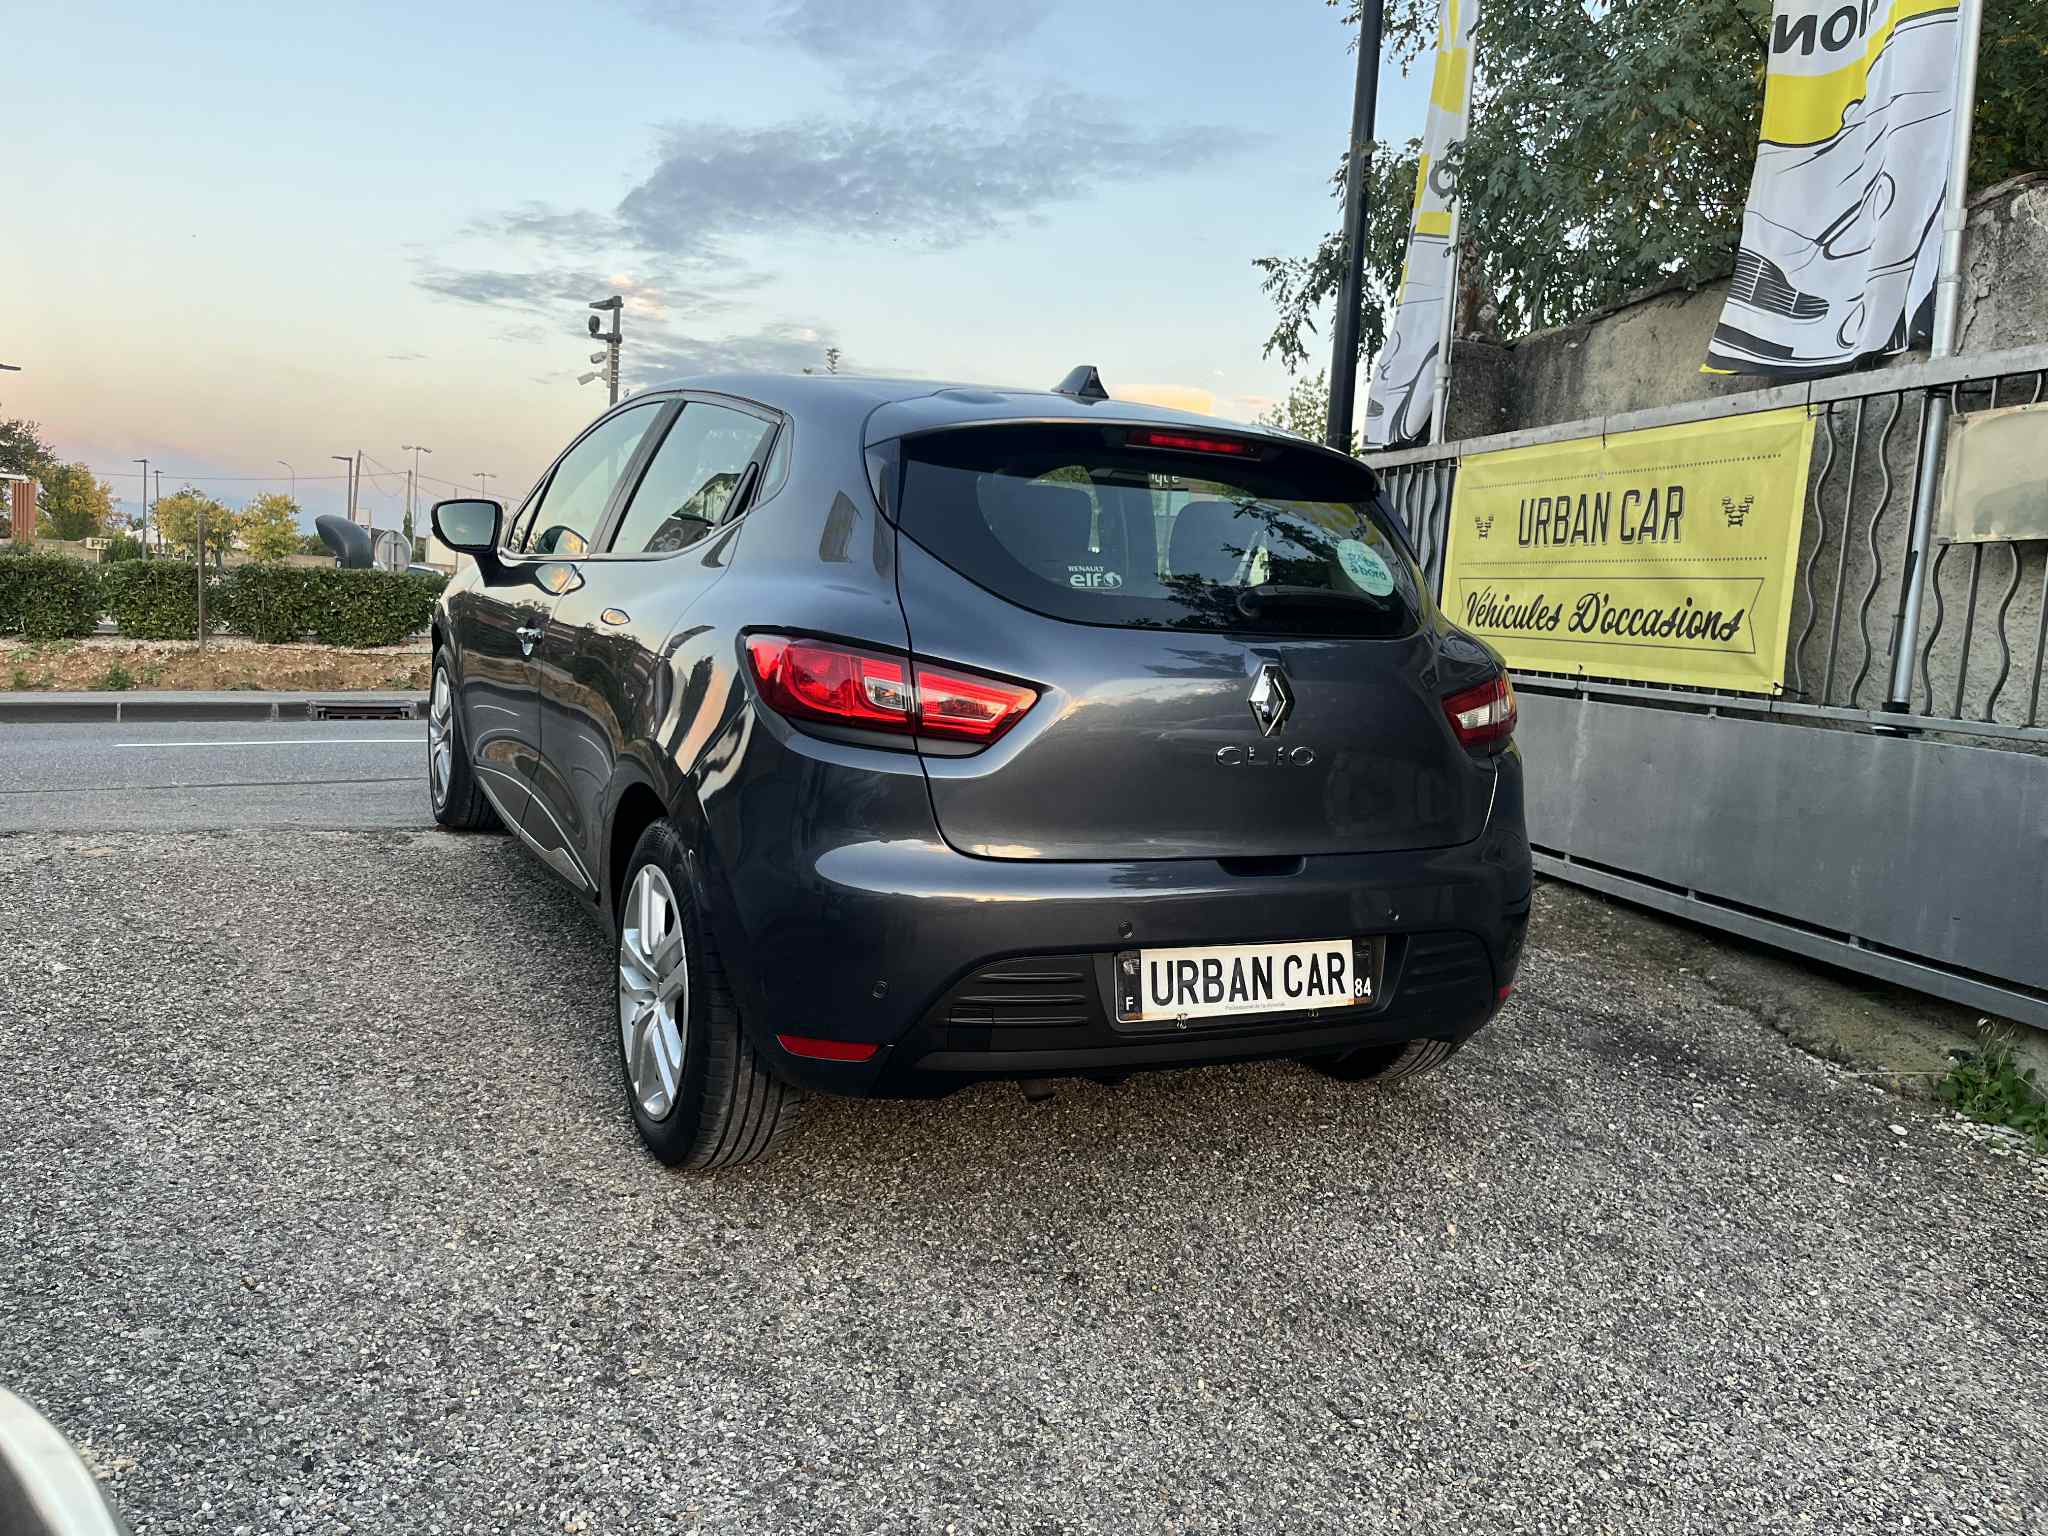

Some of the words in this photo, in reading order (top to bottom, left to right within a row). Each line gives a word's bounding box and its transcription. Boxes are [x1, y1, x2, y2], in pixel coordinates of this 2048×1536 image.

[1518, 491, 1612, 548] URBAN
[1619, 485, 1685, 544] CAR
[1069, 573, 1102, 587] elf
[1466, 585, 1564, 632] Véhicules
[1567, 593, 1746, 642] D'occasions
[1216, 746, 1314, 767] CLIO
[1150, 954, 1271, 1007] URBAN
[1283, 951, 1346, 998] CAR
[1354, 976, 1372, 997] 84
[1125, 996, 1134, 1011] F
